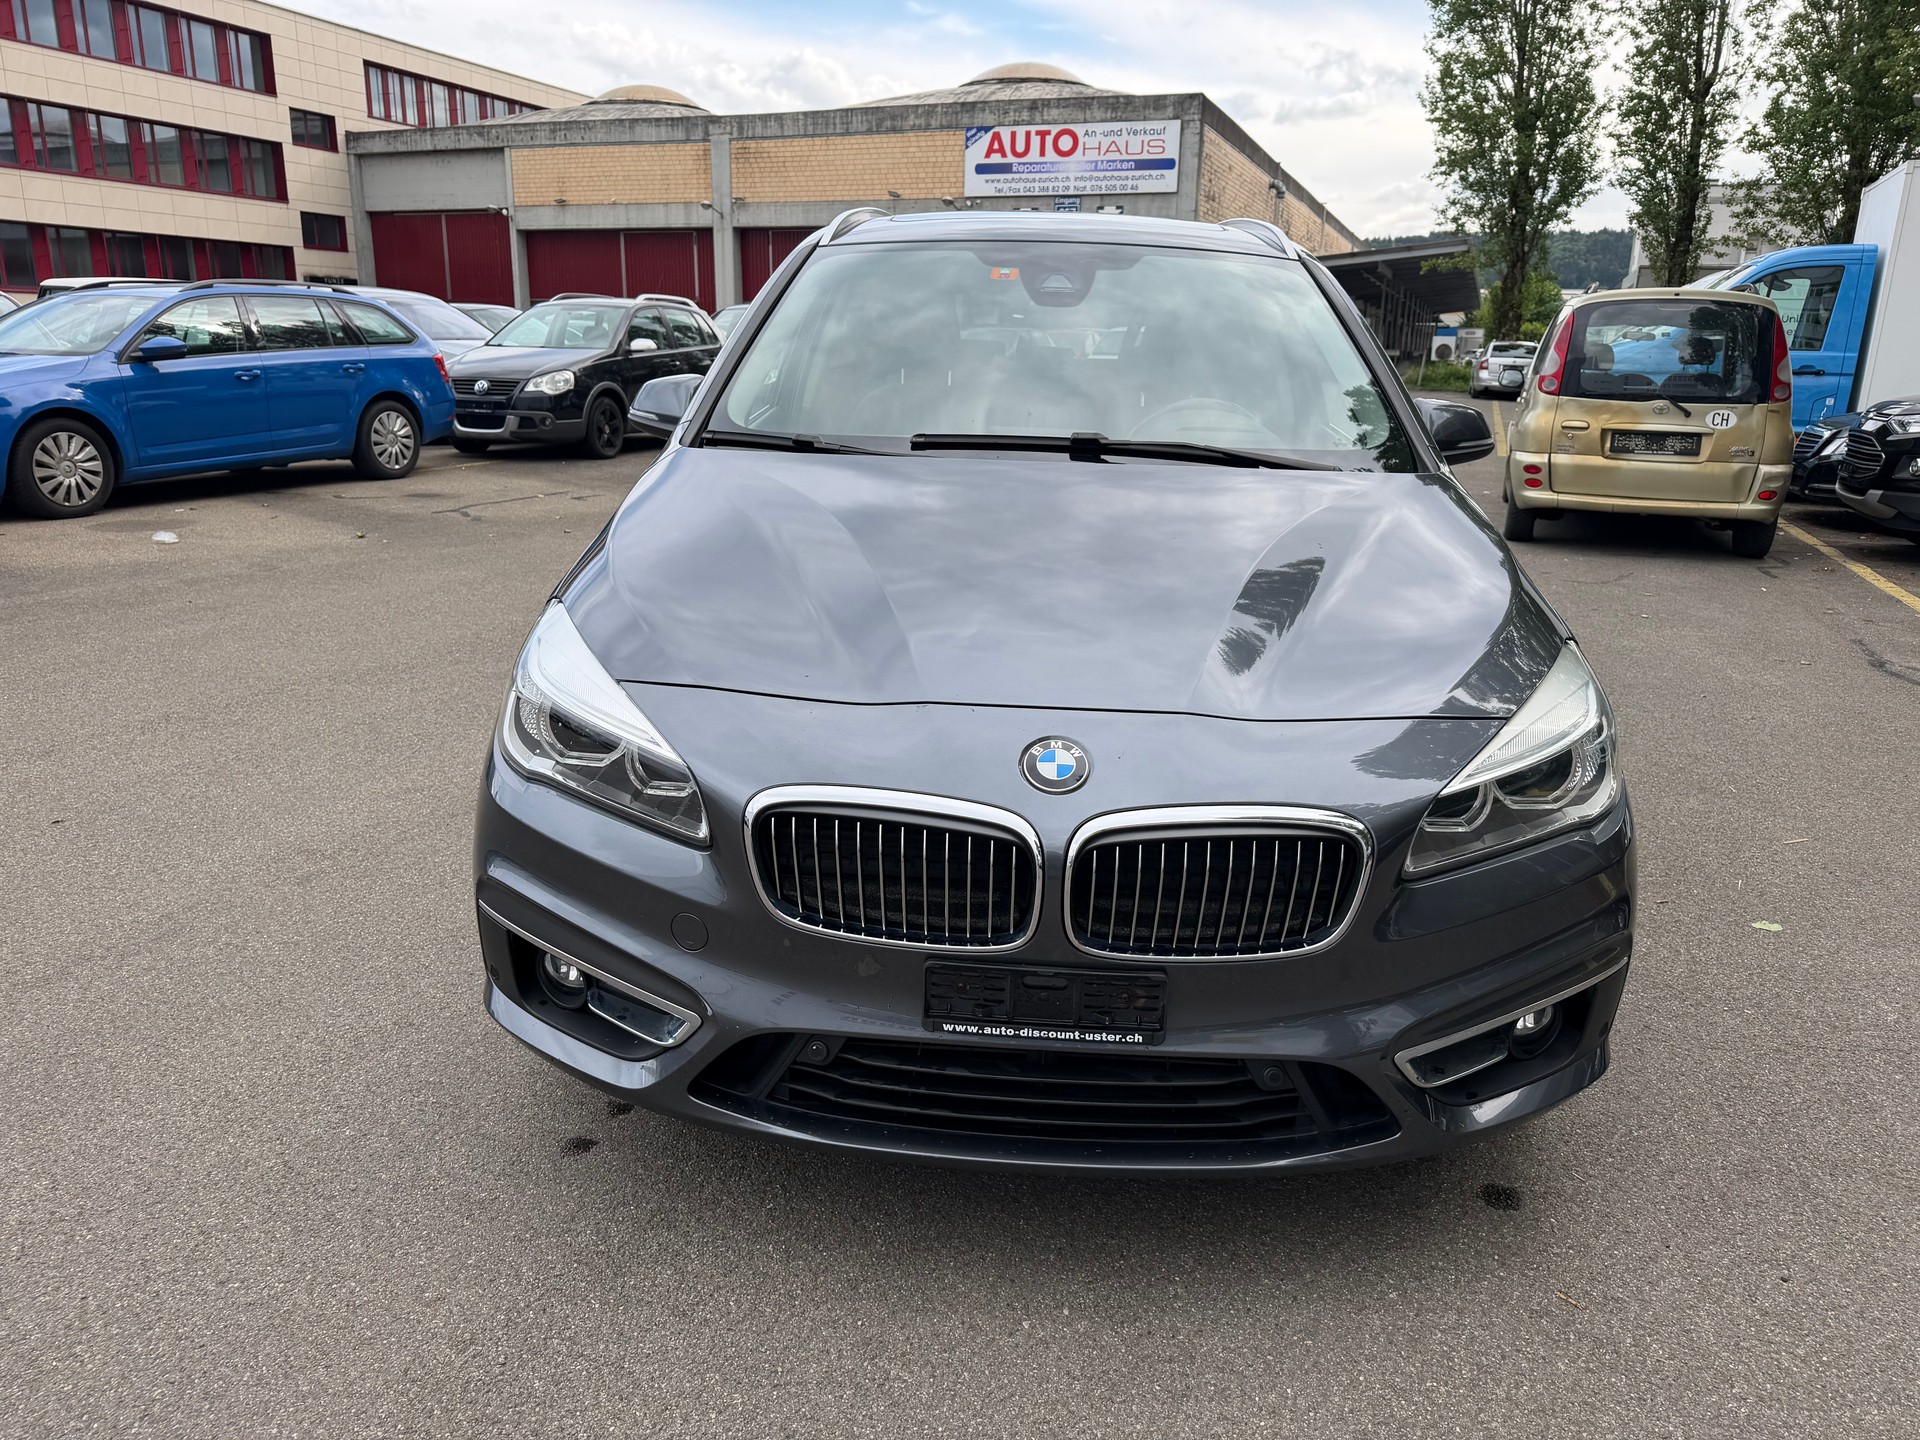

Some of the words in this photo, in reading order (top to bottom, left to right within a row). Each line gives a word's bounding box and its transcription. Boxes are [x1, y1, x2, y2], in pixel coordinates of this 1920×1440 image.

[1083, 129, 1097, 138] An
[1125, 126, 1166, 136] Verkauf
[984, 128, 1079, 159] AUTO
[1082, 138, 1166, 157] HAUS
[1097, 160, 1135, 170] Marken
[1055, 197, 1080, 205] Eingang
[1711, 412, 1730, 427] CH
[1030, 741, 1083, 757] BMW
[942, 1022, 1143, 1043] www.auto-discount-uster.ch
